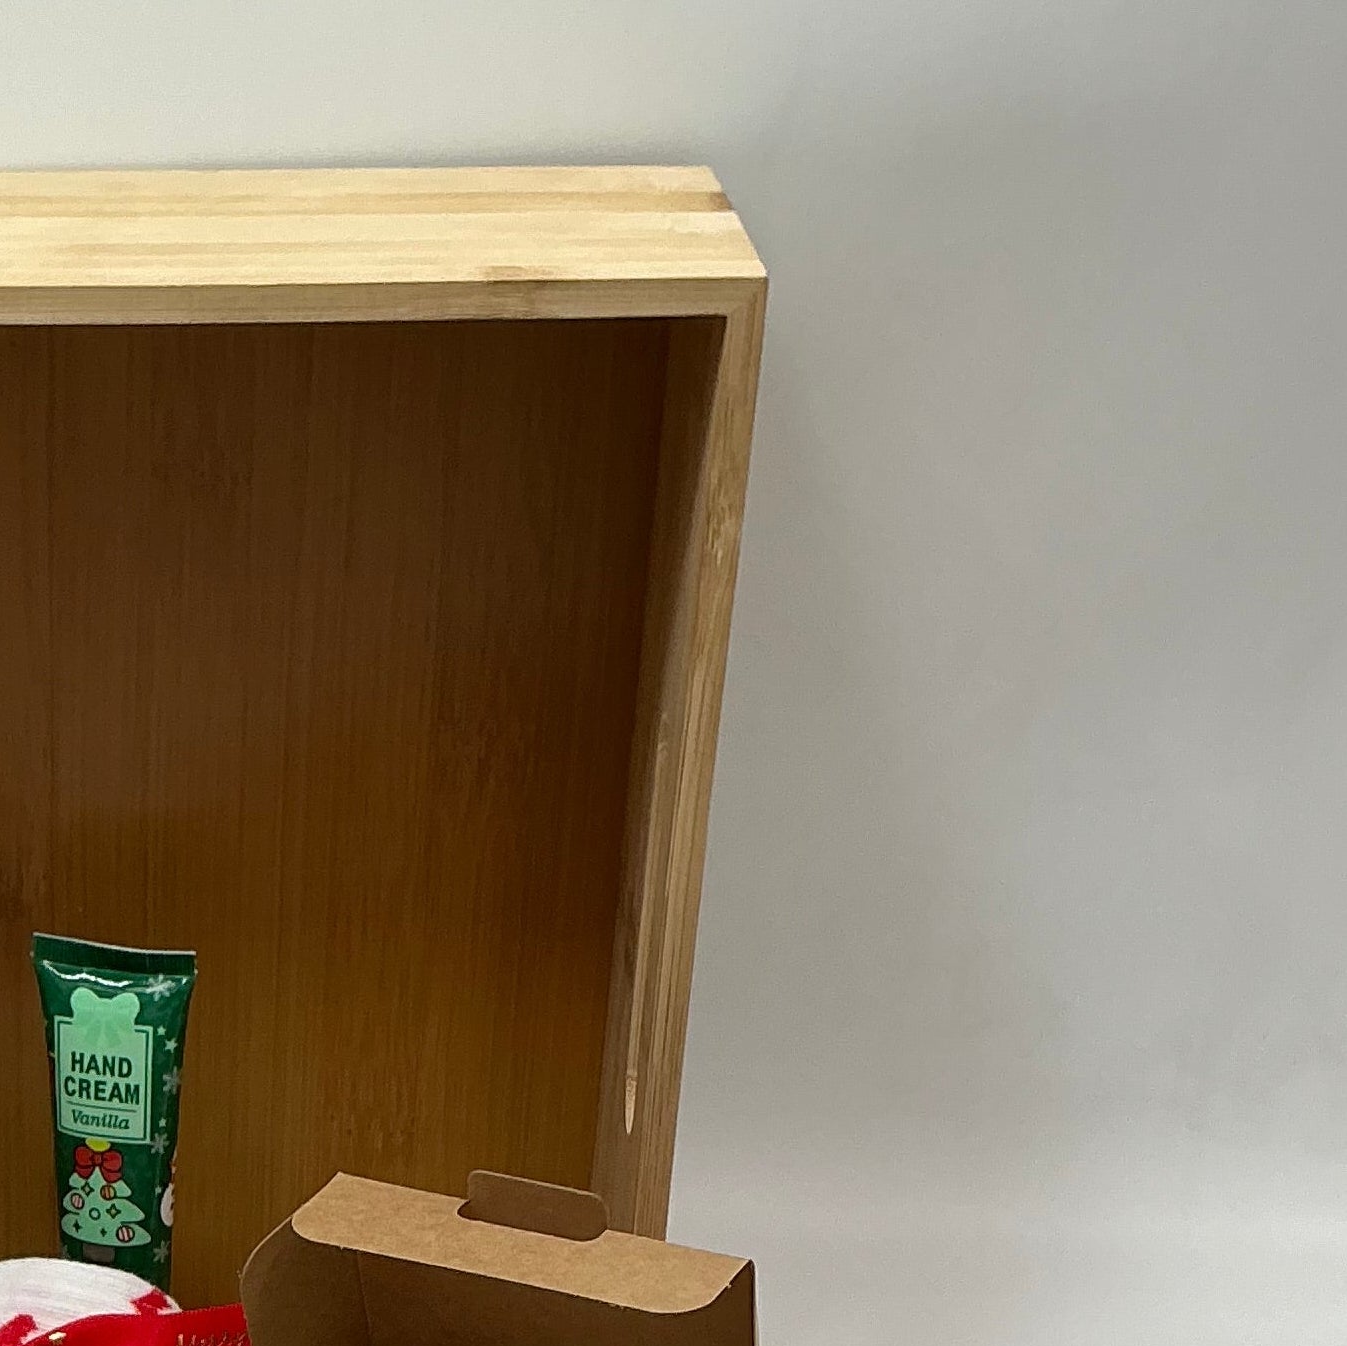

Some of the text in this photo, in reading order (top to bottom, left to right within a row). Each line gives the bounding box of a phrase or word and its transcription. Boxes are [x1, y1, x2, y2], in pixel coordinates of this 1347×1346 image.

[70, 1051, 133, 1079] HAND
[64, 1075, 141, 1106] CREAM
[71, 1109, 131, 1130] Vanilla
